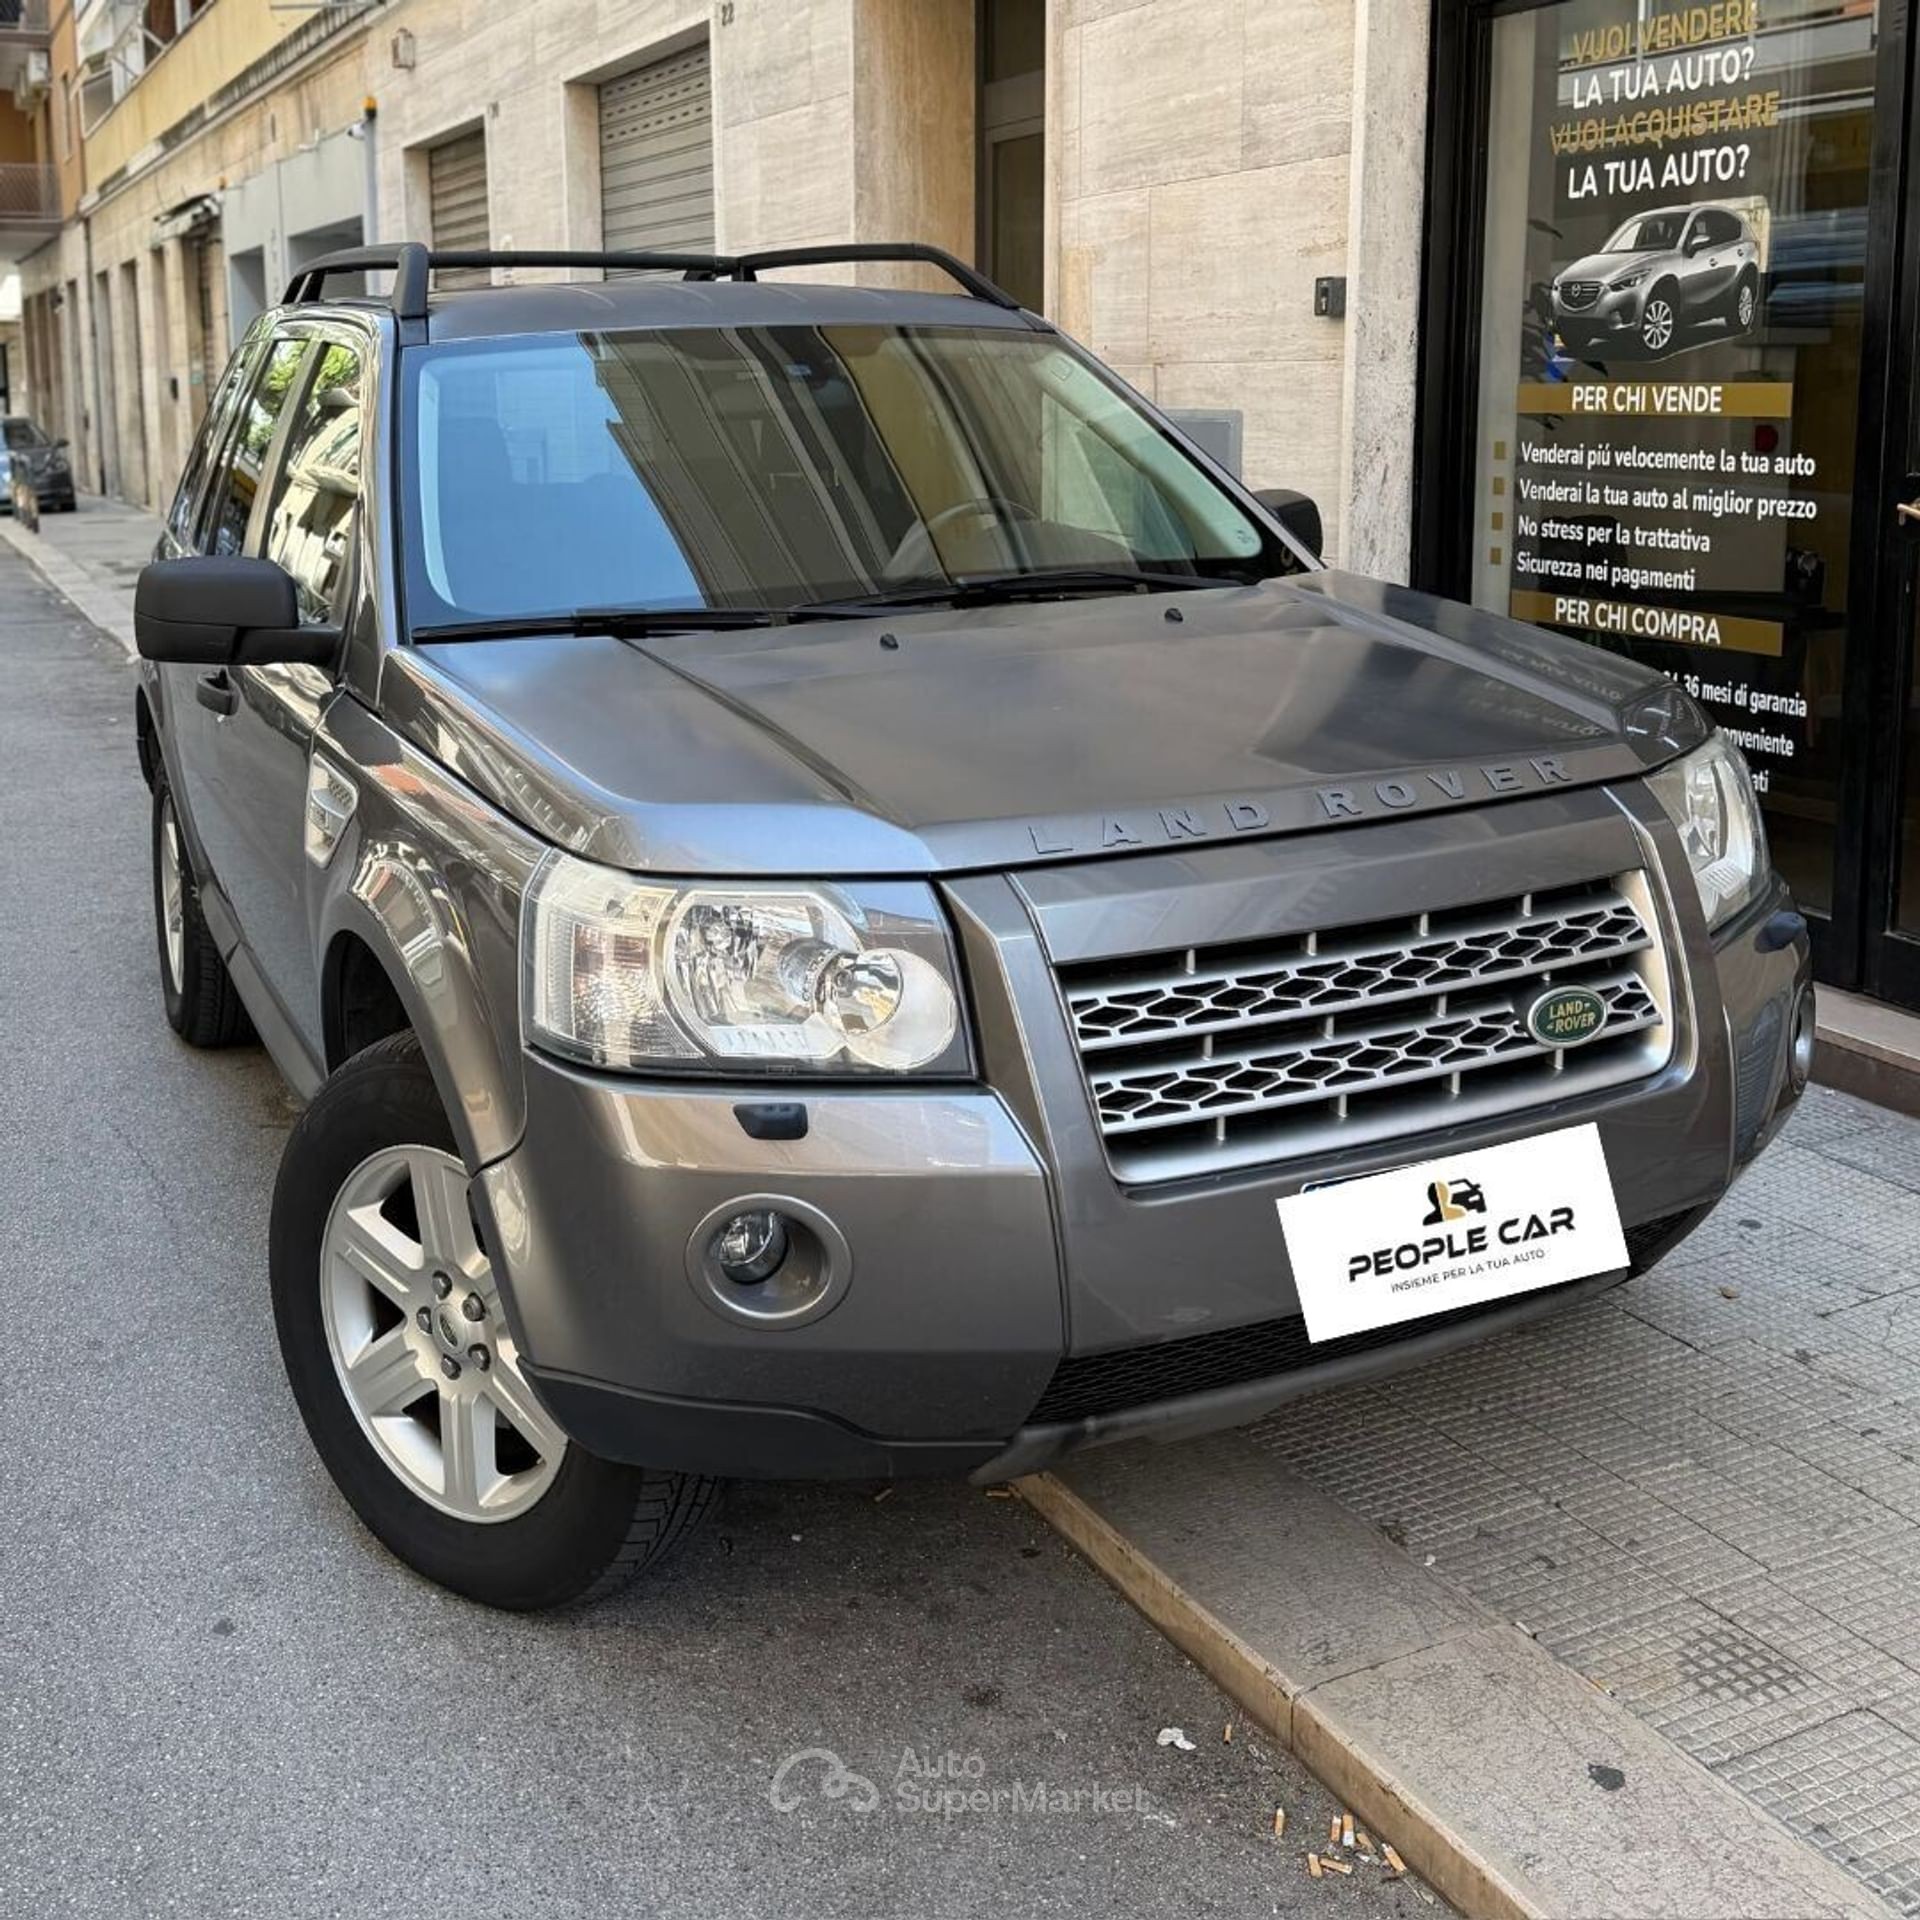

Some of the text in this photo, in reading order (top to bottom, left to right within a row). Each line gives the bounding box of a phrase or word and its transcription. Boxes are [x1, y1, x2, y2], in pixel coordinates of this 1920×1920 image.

[1573, 0, 1758, 63] VUOI VENDERE
[1573, 46, 1755, 109] LA TUA AUTO?
[1551, 90, 1780, 155] VUOI ACQUISTARE
[1568, 144, 1750, 198] LA TUA AUTO?
[1571, 386, 1722, 413] PER CHI VENDE
[1521, 441, 1584, 465] Venderai
[1614, 446, 1715, 471] velocemente
[1720, 449, 1736, 473] la
[1741, 451, 1769, 475] tua
[1774, 453, 1816, 476] auto
[1519, 478, 1817, 521] Venderai la tua auto al miglior prezzo
[1517, 515, 1711, 552] No stress per la trattativa
[1516, 551, 1696, 592] Sicurezza nei pagamenti
[1555, 597, 1721, 645] PER CHI COMPRA
[1701, 681, 1732, 704] mesi
[1734, 684, 1748, 707] di
[1749, 692, 1808, 718] garanzia
[1716, 725, 1795, 757] nveniente
[1027, 753, 1573, 855] LAND ROVER
